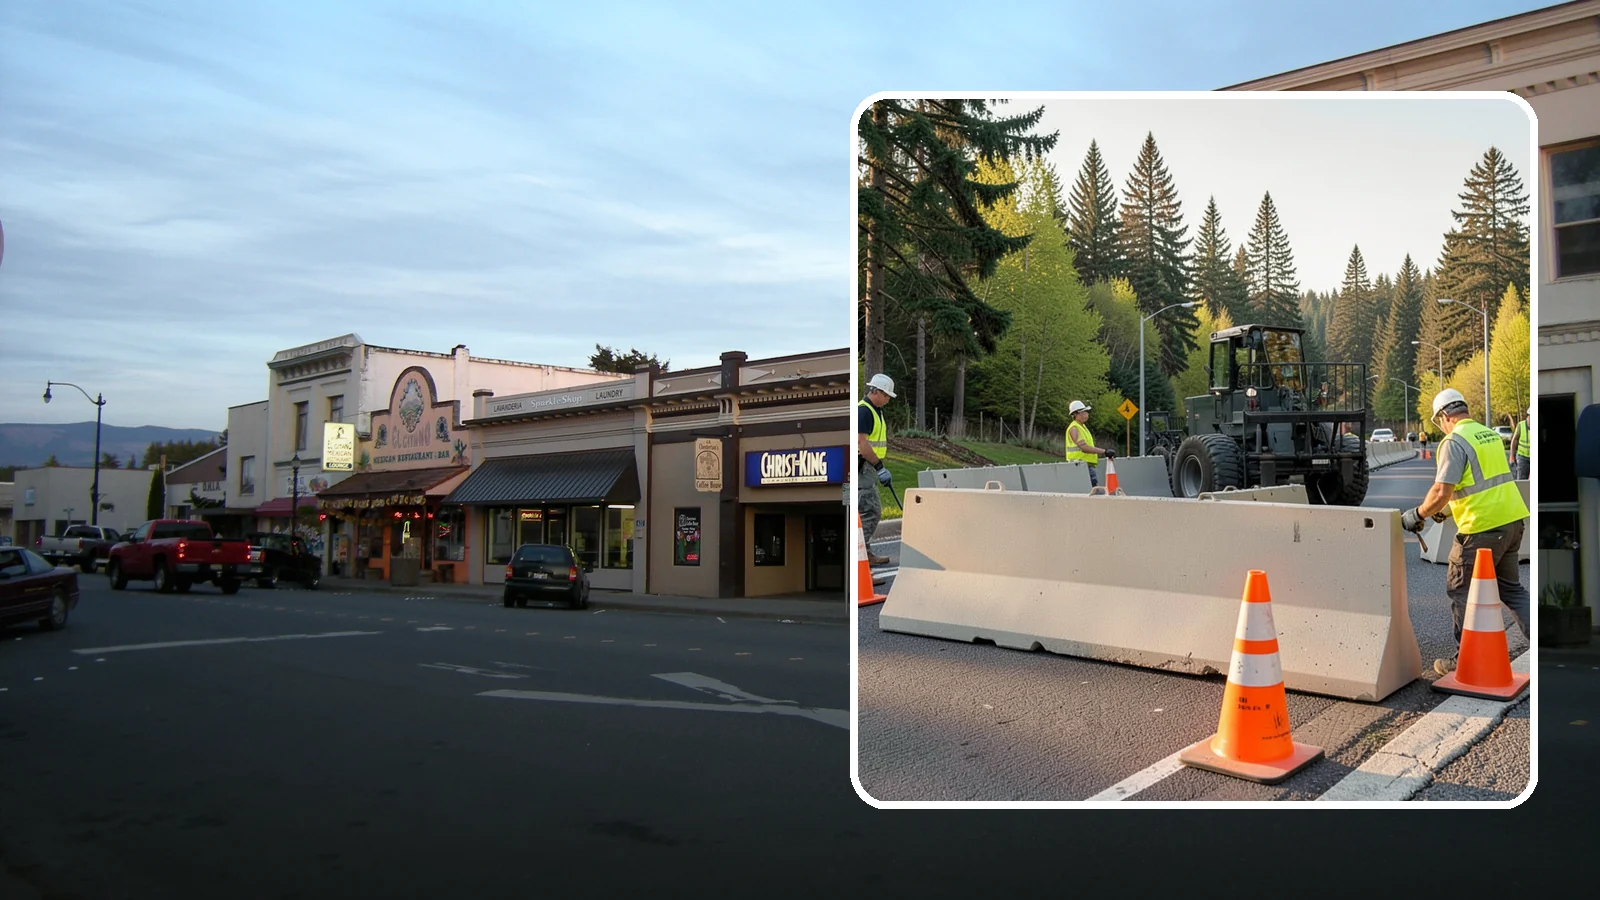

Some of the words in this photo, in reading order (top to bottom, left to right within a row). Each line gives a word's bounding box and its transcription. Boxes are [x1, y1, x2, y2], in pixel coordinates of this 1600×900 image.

[595, 389, 623, 399] LAUNDRY
[493, 402, 522, 413] LAVANDERIA
[531, 398, 560, 409] Sparkle
[562, 394, 582, 404] Shop
[373, 454, 396, 464] MEXICAN
[397, 451, 434, 462] RESTAURANT
[437, 450, 450, 459] BAR
[760, 452, 797, 478] CHRIST
[799, 450, 827, 476] KING
[696, 480, 709, 489] Coffee
[709, 480, 722, 489] House
